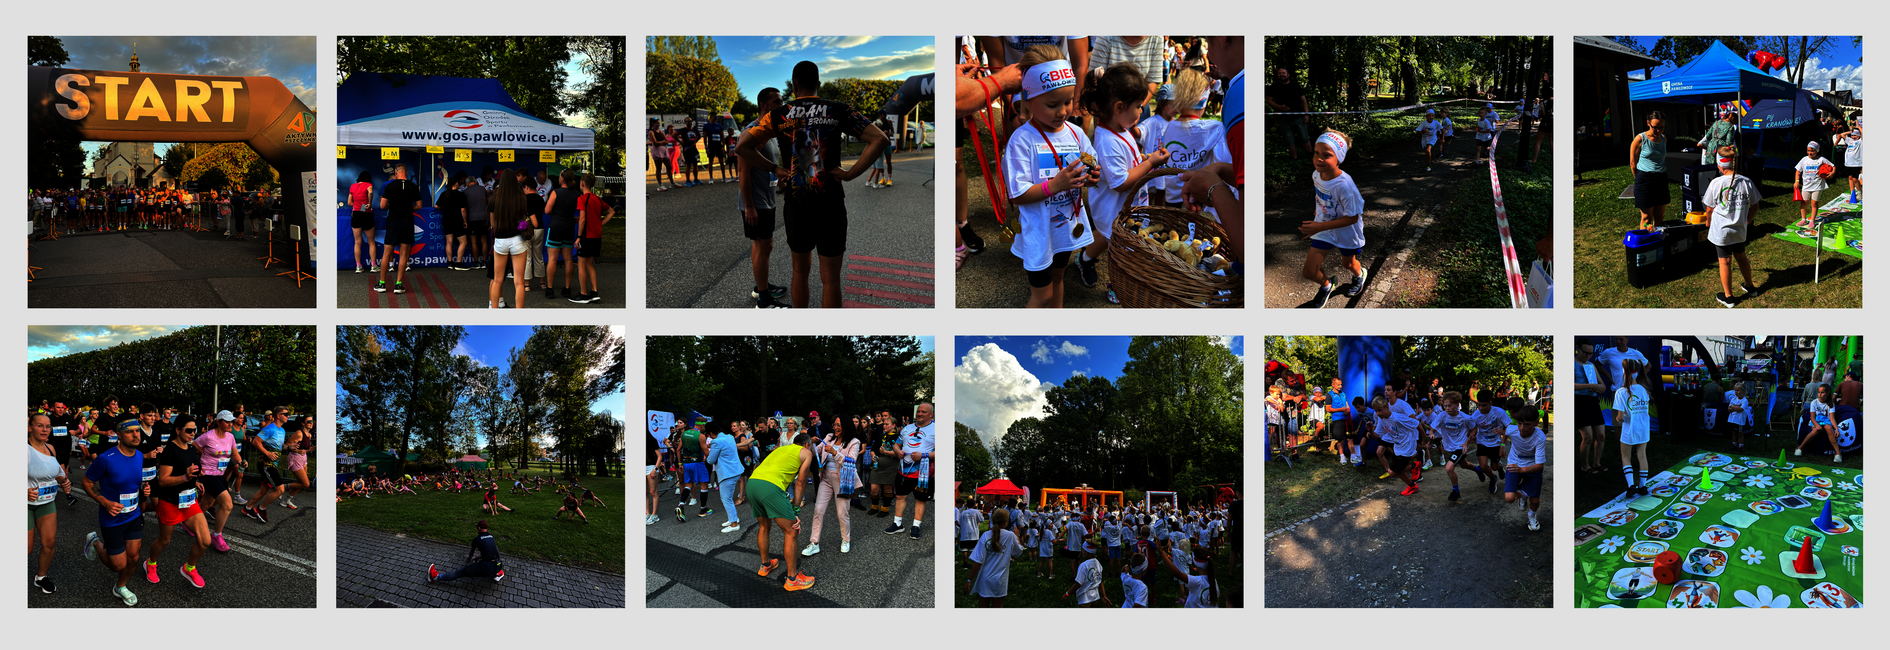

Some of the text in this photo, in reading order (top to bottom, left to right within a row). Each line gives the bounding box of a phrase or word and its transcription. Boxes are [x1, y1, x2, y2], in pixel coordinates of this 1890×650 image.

[54, 73, 243, 123] START
[786, 104, 828, 120] ADAM
[402, 131, 564, 145] www.gos.pawlowice.pl
[1171, 149, 1207, 163] Carbo
[44, 486, 54, 495] 226
[1823, 583, 1840, 596] 3
